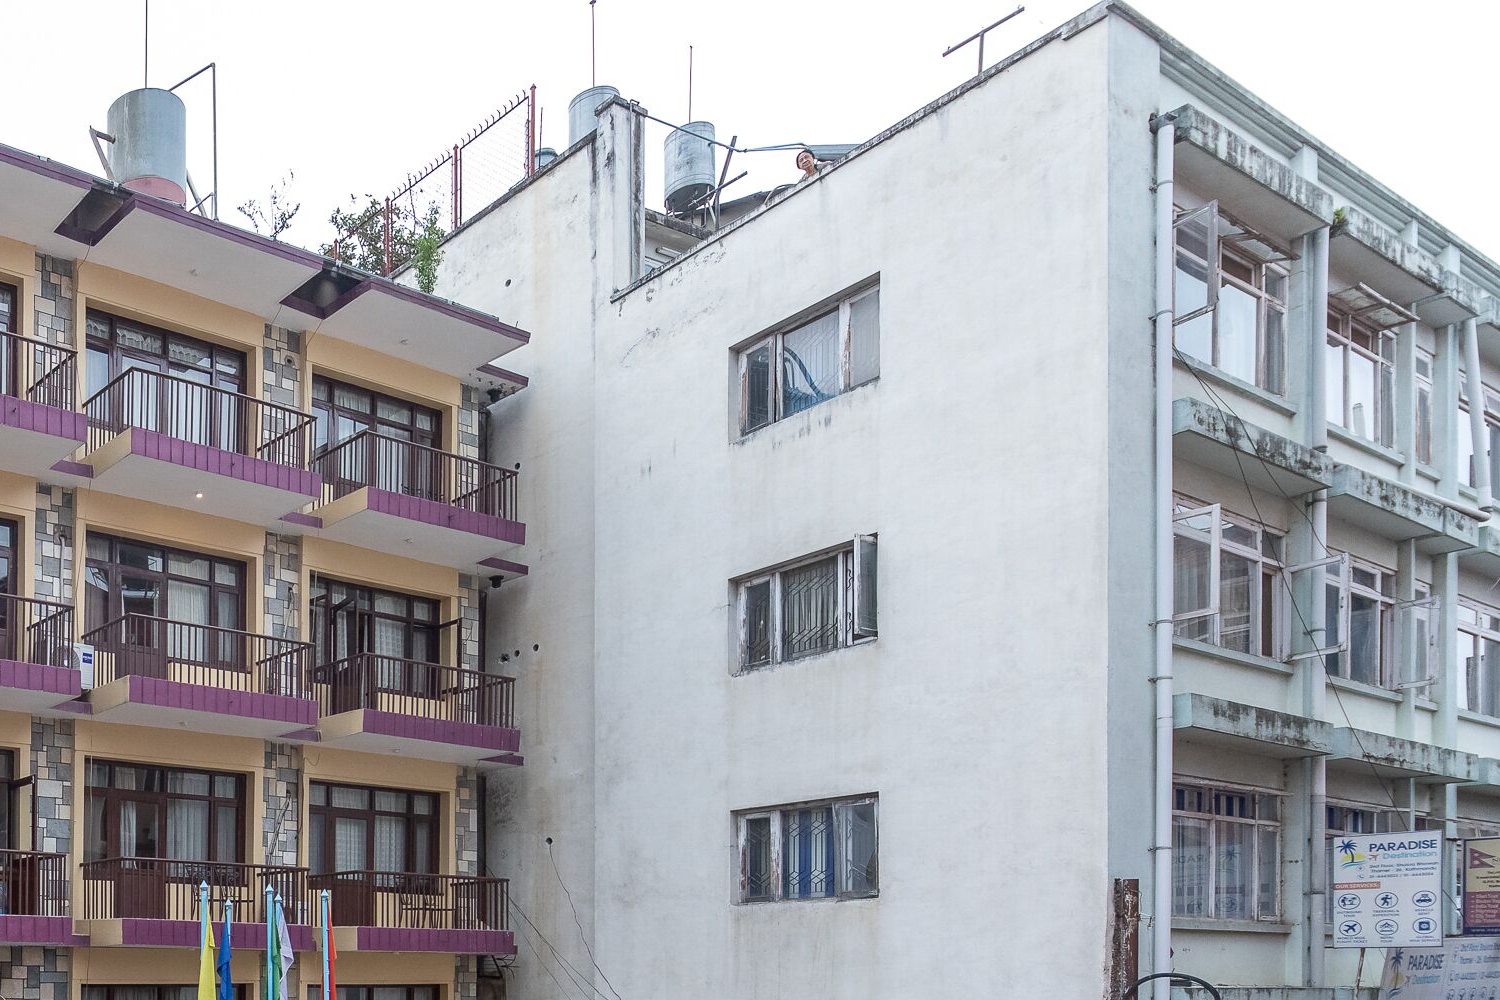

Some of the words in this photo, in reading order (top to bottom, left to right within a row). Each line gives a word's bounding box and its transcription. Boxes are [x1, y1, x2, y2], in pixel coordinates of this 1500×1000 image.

[1369, 839, 1438, 852] PARADISE
[1382, 851, 1438, 860] Destination
[1407, 954, 1445, 971] PARADISE
